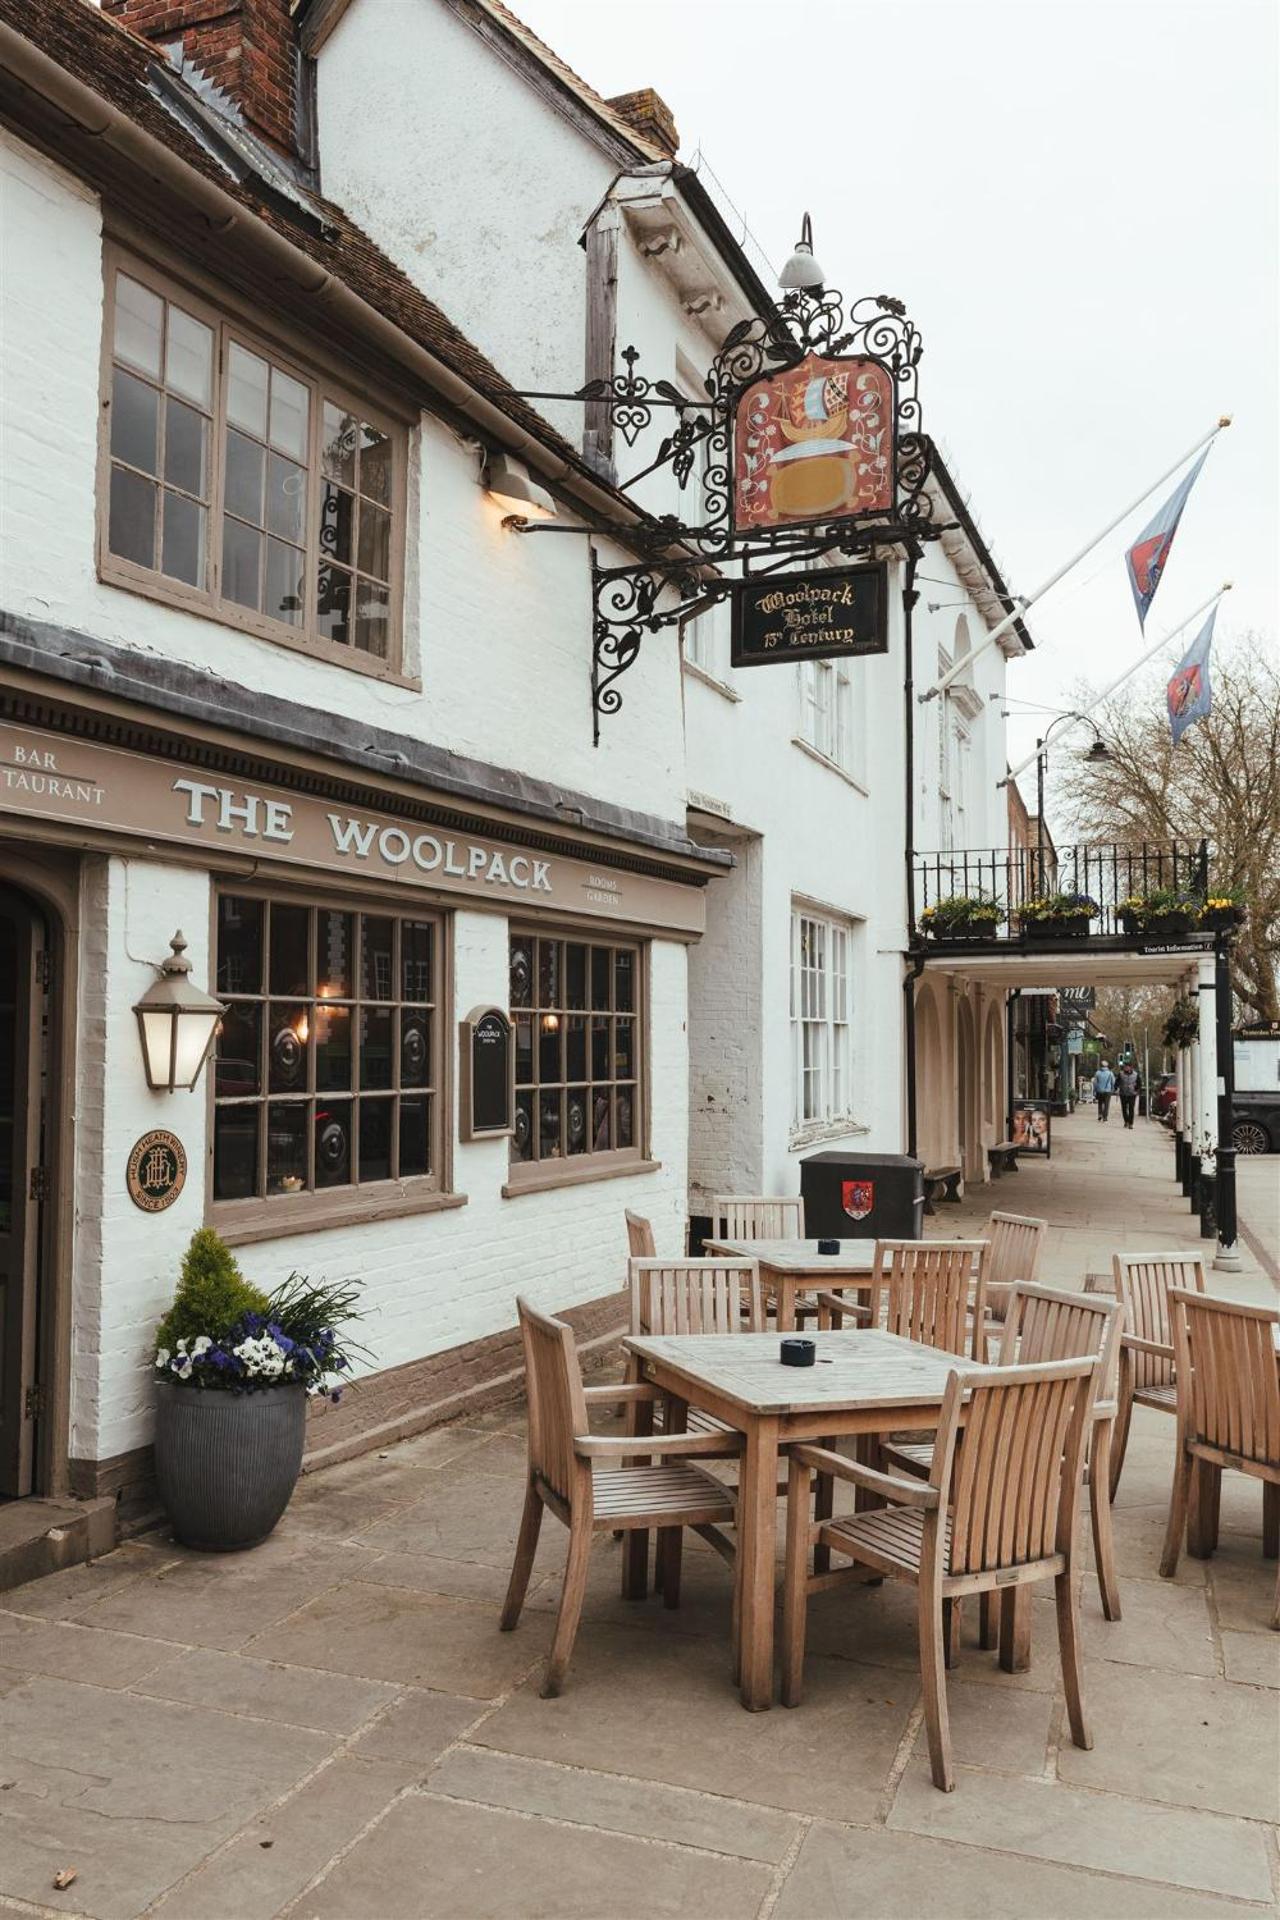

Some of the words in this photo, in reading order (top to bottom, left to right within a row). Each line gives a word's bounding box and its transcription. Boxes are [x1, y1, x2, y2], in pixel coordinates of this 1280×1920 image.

[755, 582, 856, 614] Woolpack
[782, 605, 834, 632] Hotel
[788, 626, 854, 646] Century
[14, 745, 58, 770] BAR
[172, 779, 294, 842] THE
[327, 814, 553, 892] WOOLPACK
[588, 874, 617, 890] ROOMS
[1144, 945, 1166, 954] Tourist
[1166, 943, 1204, 952] Information
